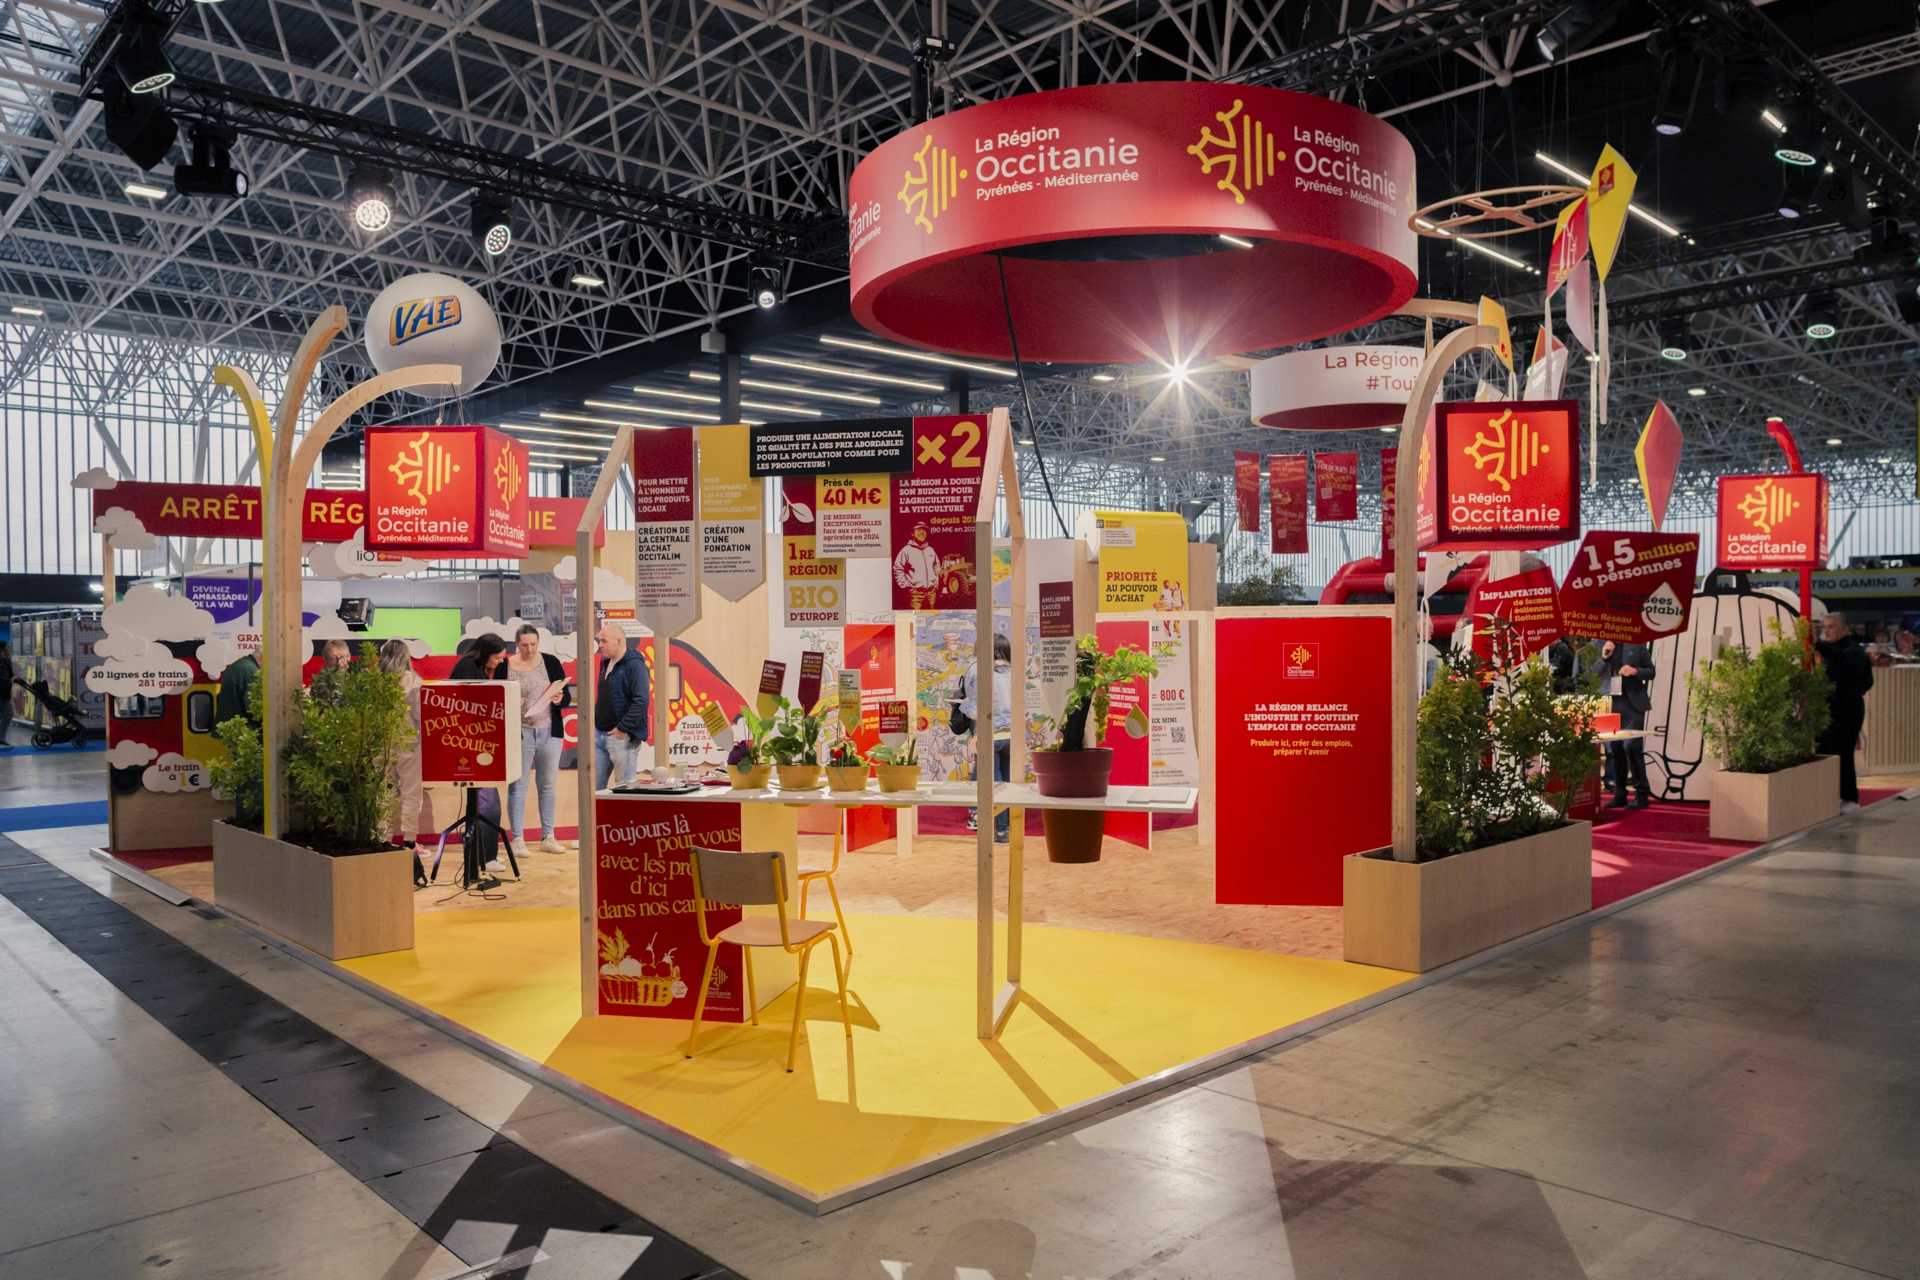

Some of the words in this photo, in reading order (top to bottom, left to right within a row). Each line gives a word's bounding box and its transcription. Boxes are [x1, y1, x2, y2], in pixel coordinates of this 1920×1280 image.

[997, 127, 1060, 148] Région
[1294, 126, 1311, 142] La
[1314, 130, 1360, 155] Région
[976, 138, 1138, 182] Occitanie
[1294, 148, 1397, 201] Occitanie
[976, 181, 1033, 200] Pyrénées
[1044, 169, 1139, 189] Méditerranée
[1296, 177, 1343, 196] Pyrénées
[396, 298, 456, 339] VAE
[1325, 355, 1348, 369] La
[1356, 352, 1418, 370] Région
[757, 435, 794, 443] PRODUIRE
[812, 432, 870, 440] ALIMENTATION
[872, 430, 904, 438] LOCALE,
[768, 442, 800, 451] QUALITÉ
[855, 440, 904, 448] ABORDABLES
[757, 453, 778, 461] POUR
[792, 451, 842, 459] POPULATION
[771, 461, 826, 469] PRODUCTEURS
[1317, 460, 1348, 474] Toujours
[1349, 465, 1356, 475] là
[659, 478, 688, 486] METTRE
[823, 479, 840, 487] Près
[842, 478, 854, 486] de
[912, 477, 940, 487] RÉGION
[644, 486, 685, 494] L'HONNEUR
[918, 486, 951, 495] BUDGET
[953, 486, 973, 494] POUR
[638, 496, 653, 504] NOS
[823, 489, 846, 505] 40
[900, 496, 961, 504] L'AGRICULTURE
[1468, 493, 1511, 505] Région
[160, 493, 258, 520] ARRÊT
[392, 506, 427, 517] Région
[912, 505, 964, 513] VITICULTURE
[1452, 504, 1560, 523] Occitanie
[378, 516, 469, 533] Occitanie
[930, 516, 960, 525] depuis
[962, 516, 976, 524] 201
[638, 526, 678, 534] CRÉATION
[680, 526, 690, 534] DE
[704, 525, 745, 534] CRÉATION
[1452, 525, 1492, 533] Pyrénées
[1500, 523, 1560, 532] Méditerranée
[377, 534, 412, 543] Pyrénées
[418, 534, 468, 542] Méditerranée
[638, 536, 649, 544] LA
[650, 535, 690, 543] CENTRALE
[1740, 534, 1771, 542] Région
[638, 544, 671, 552] D'ACHAT
[704, 544, 750, 552] FONDATION
[1728, 541, 1807, 554] Occitanie
[638, 553, 680, 561] OCCITALIM
[1583, 538, 1636, 572] 1,5
[1638, 541, 1697, 561] million
[789, 562, 838, 576] RÉGION
[1597, 558, 1682, 586] personnes
[1106, 570, 1157, 581] PRIORITÉ
[1844, 578, 1898, 589] GAMING
[789, 586, 838, 609] BIO
[1041, 595, 1070, 603] AMÉLIORER
[1106, 594, 1144, 602] D'ACHAT
[1606, 592, 1672, 606] sécurisées
[1514, 606, 1553, 614] éoliennes
[1609, 602, 1633, 610] eau
[790, 612, 839, 621] D'EUROPE
[1514, 613, 1554, 621] flottantes
[1537, 627, 1557, 635] pleine
[106, 670, 140, 682] lignes
[142, 670, 155, 678] de
[158, 670, 188, 678] trains
[158, 680, 188, 690] gares
[1160, 690, 1176, 700] 800
[1179, 690, 1185, 700] €
[421, 687, 488, 716] Toujours
[491, 701, 504, 720] là
[1269, 702, 1304, 711] RÉGION
[424, 714, 460, 736] pour
[458, 720, 496, 736] vous
[442, 729, 499, 754] écouter
[1281, 739, 1291, 747] ici,
[1325, 739, 1353, 747] emplois,
[1274, 748, 1302, 756] préparer
[1304, 747, 1329, 755] l'avenir
[158, 764, 171, 772] Le
[174, 764, 200, 772] train
[597, 820, 671, 846] Toujours
[674, 814, 690, 834] là
[698, 827, 740, 846] vous
[600, 854, 639, 872] avec
[598, 900, 636, 919] dans
